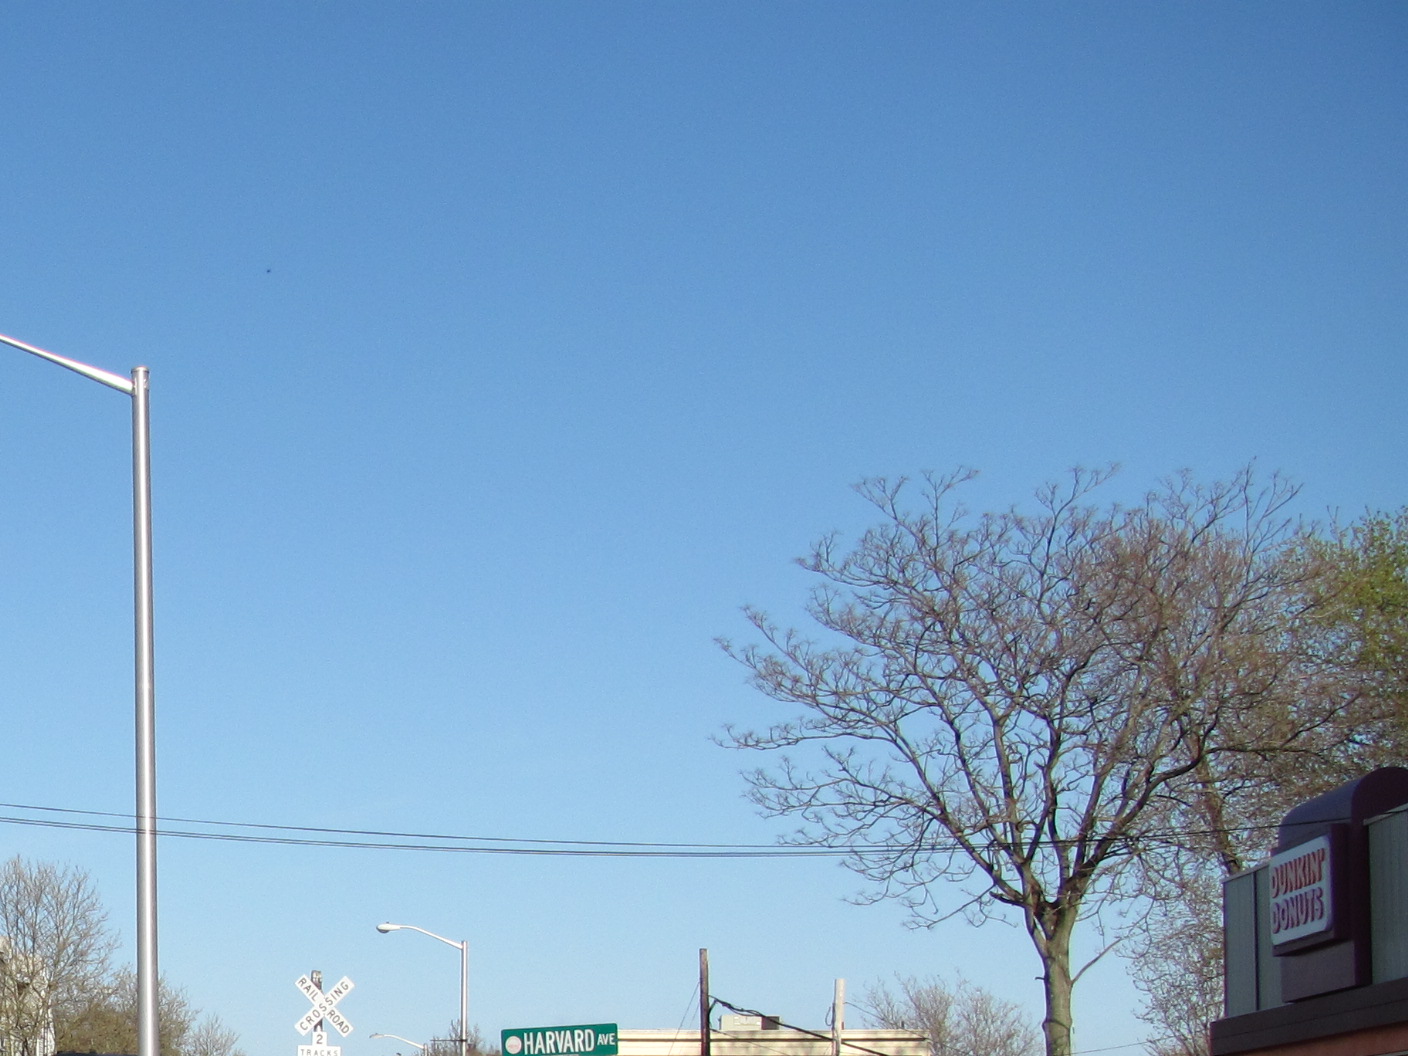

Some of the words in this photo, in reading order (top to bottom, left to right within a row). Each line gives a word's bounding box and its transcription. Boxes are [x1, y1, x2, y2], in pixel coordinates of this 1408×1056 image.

[1272, 848, 1325, 899] DUNKIN'
[1272, 887, 1324, 934] DONUTS
[298, 977, 318, 1002] RAIL
[327, 1009, 350, 1034] ROAD
[299, 981, 349, 1031] CROSSING
[300, 1049, 338, 1056] TRACKS
[316, 1034, 323, 1045] 2
[523, 1029, 595, 1055] HARVARD
[597, 1033, 616, 1046] AVE
